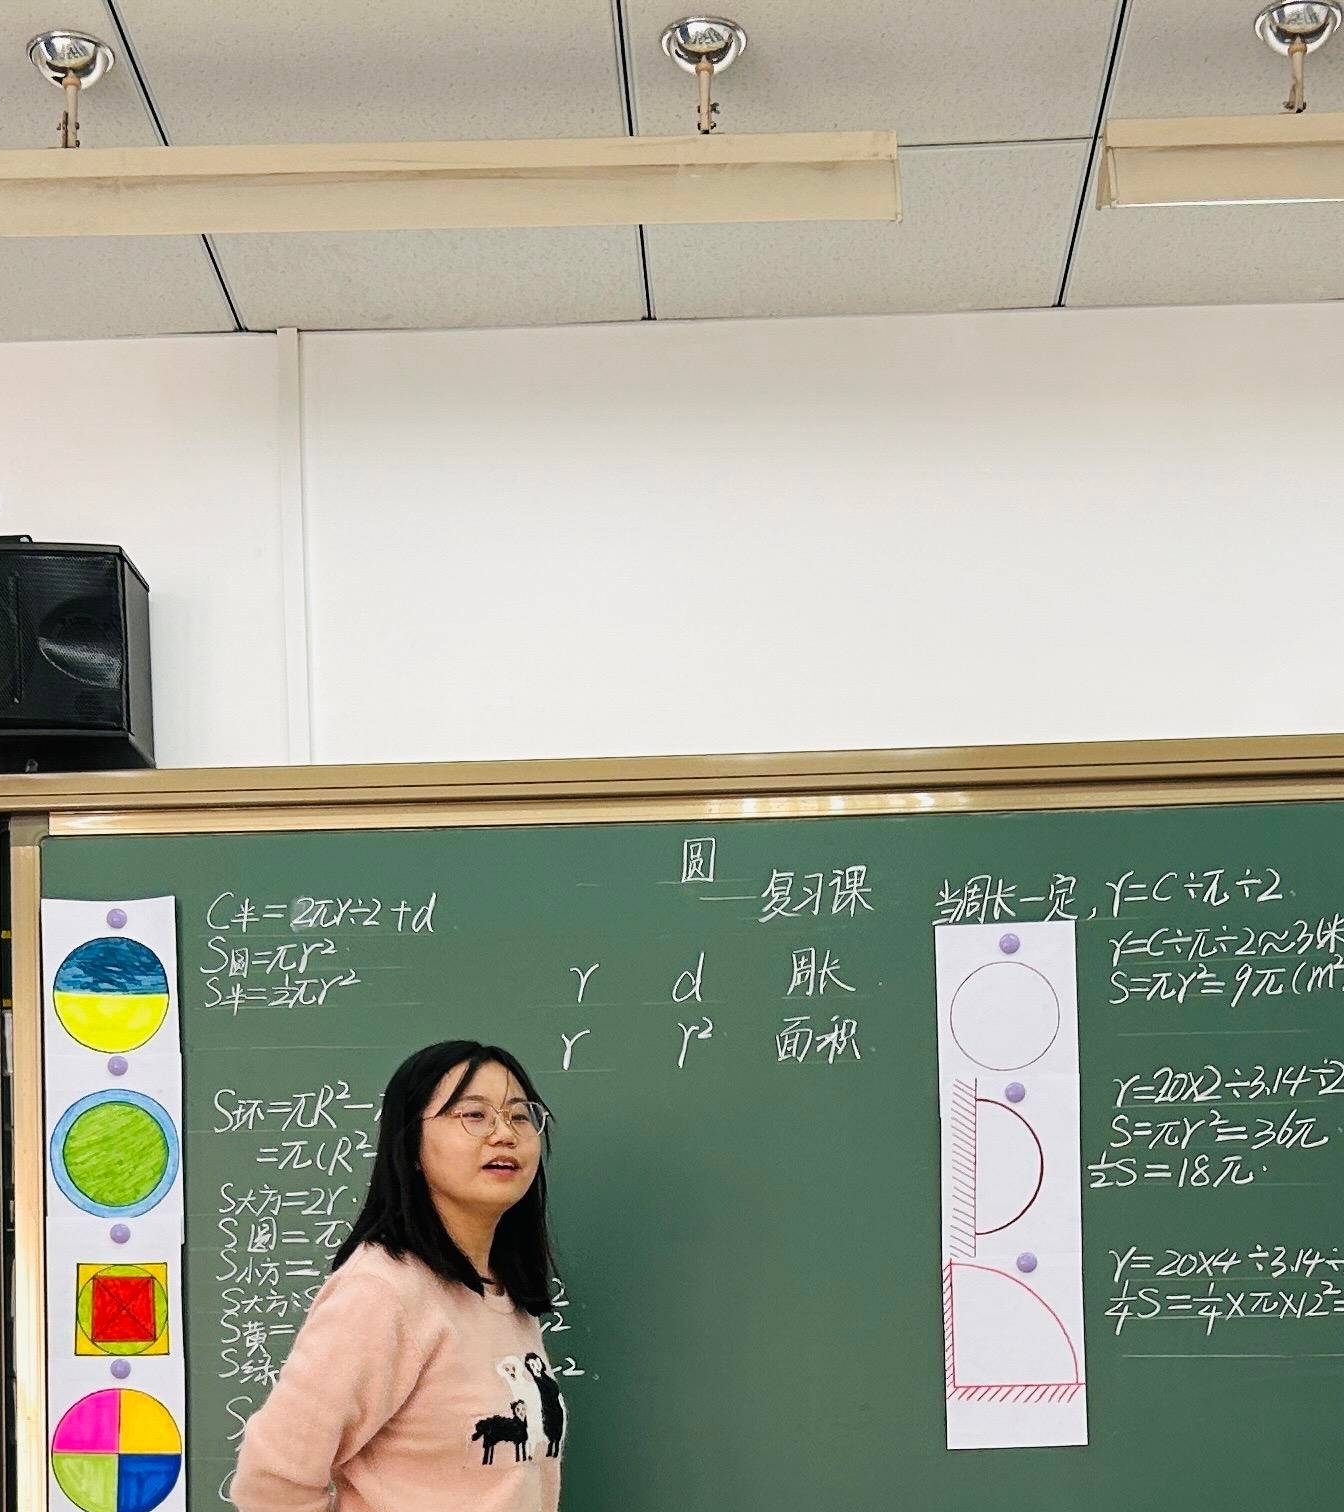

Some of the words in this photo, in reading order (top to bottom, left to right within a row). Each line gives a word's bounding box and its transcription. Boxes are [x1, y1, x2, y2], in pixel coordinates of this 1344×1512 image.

[681, 837, 716, 884] 圆
[757, 864, 875, 924] 复习课
[670, 951, 706, 1003] d
[786, 946, 857, 997] 周长
[775, 1014, 862, 1065] 面积
